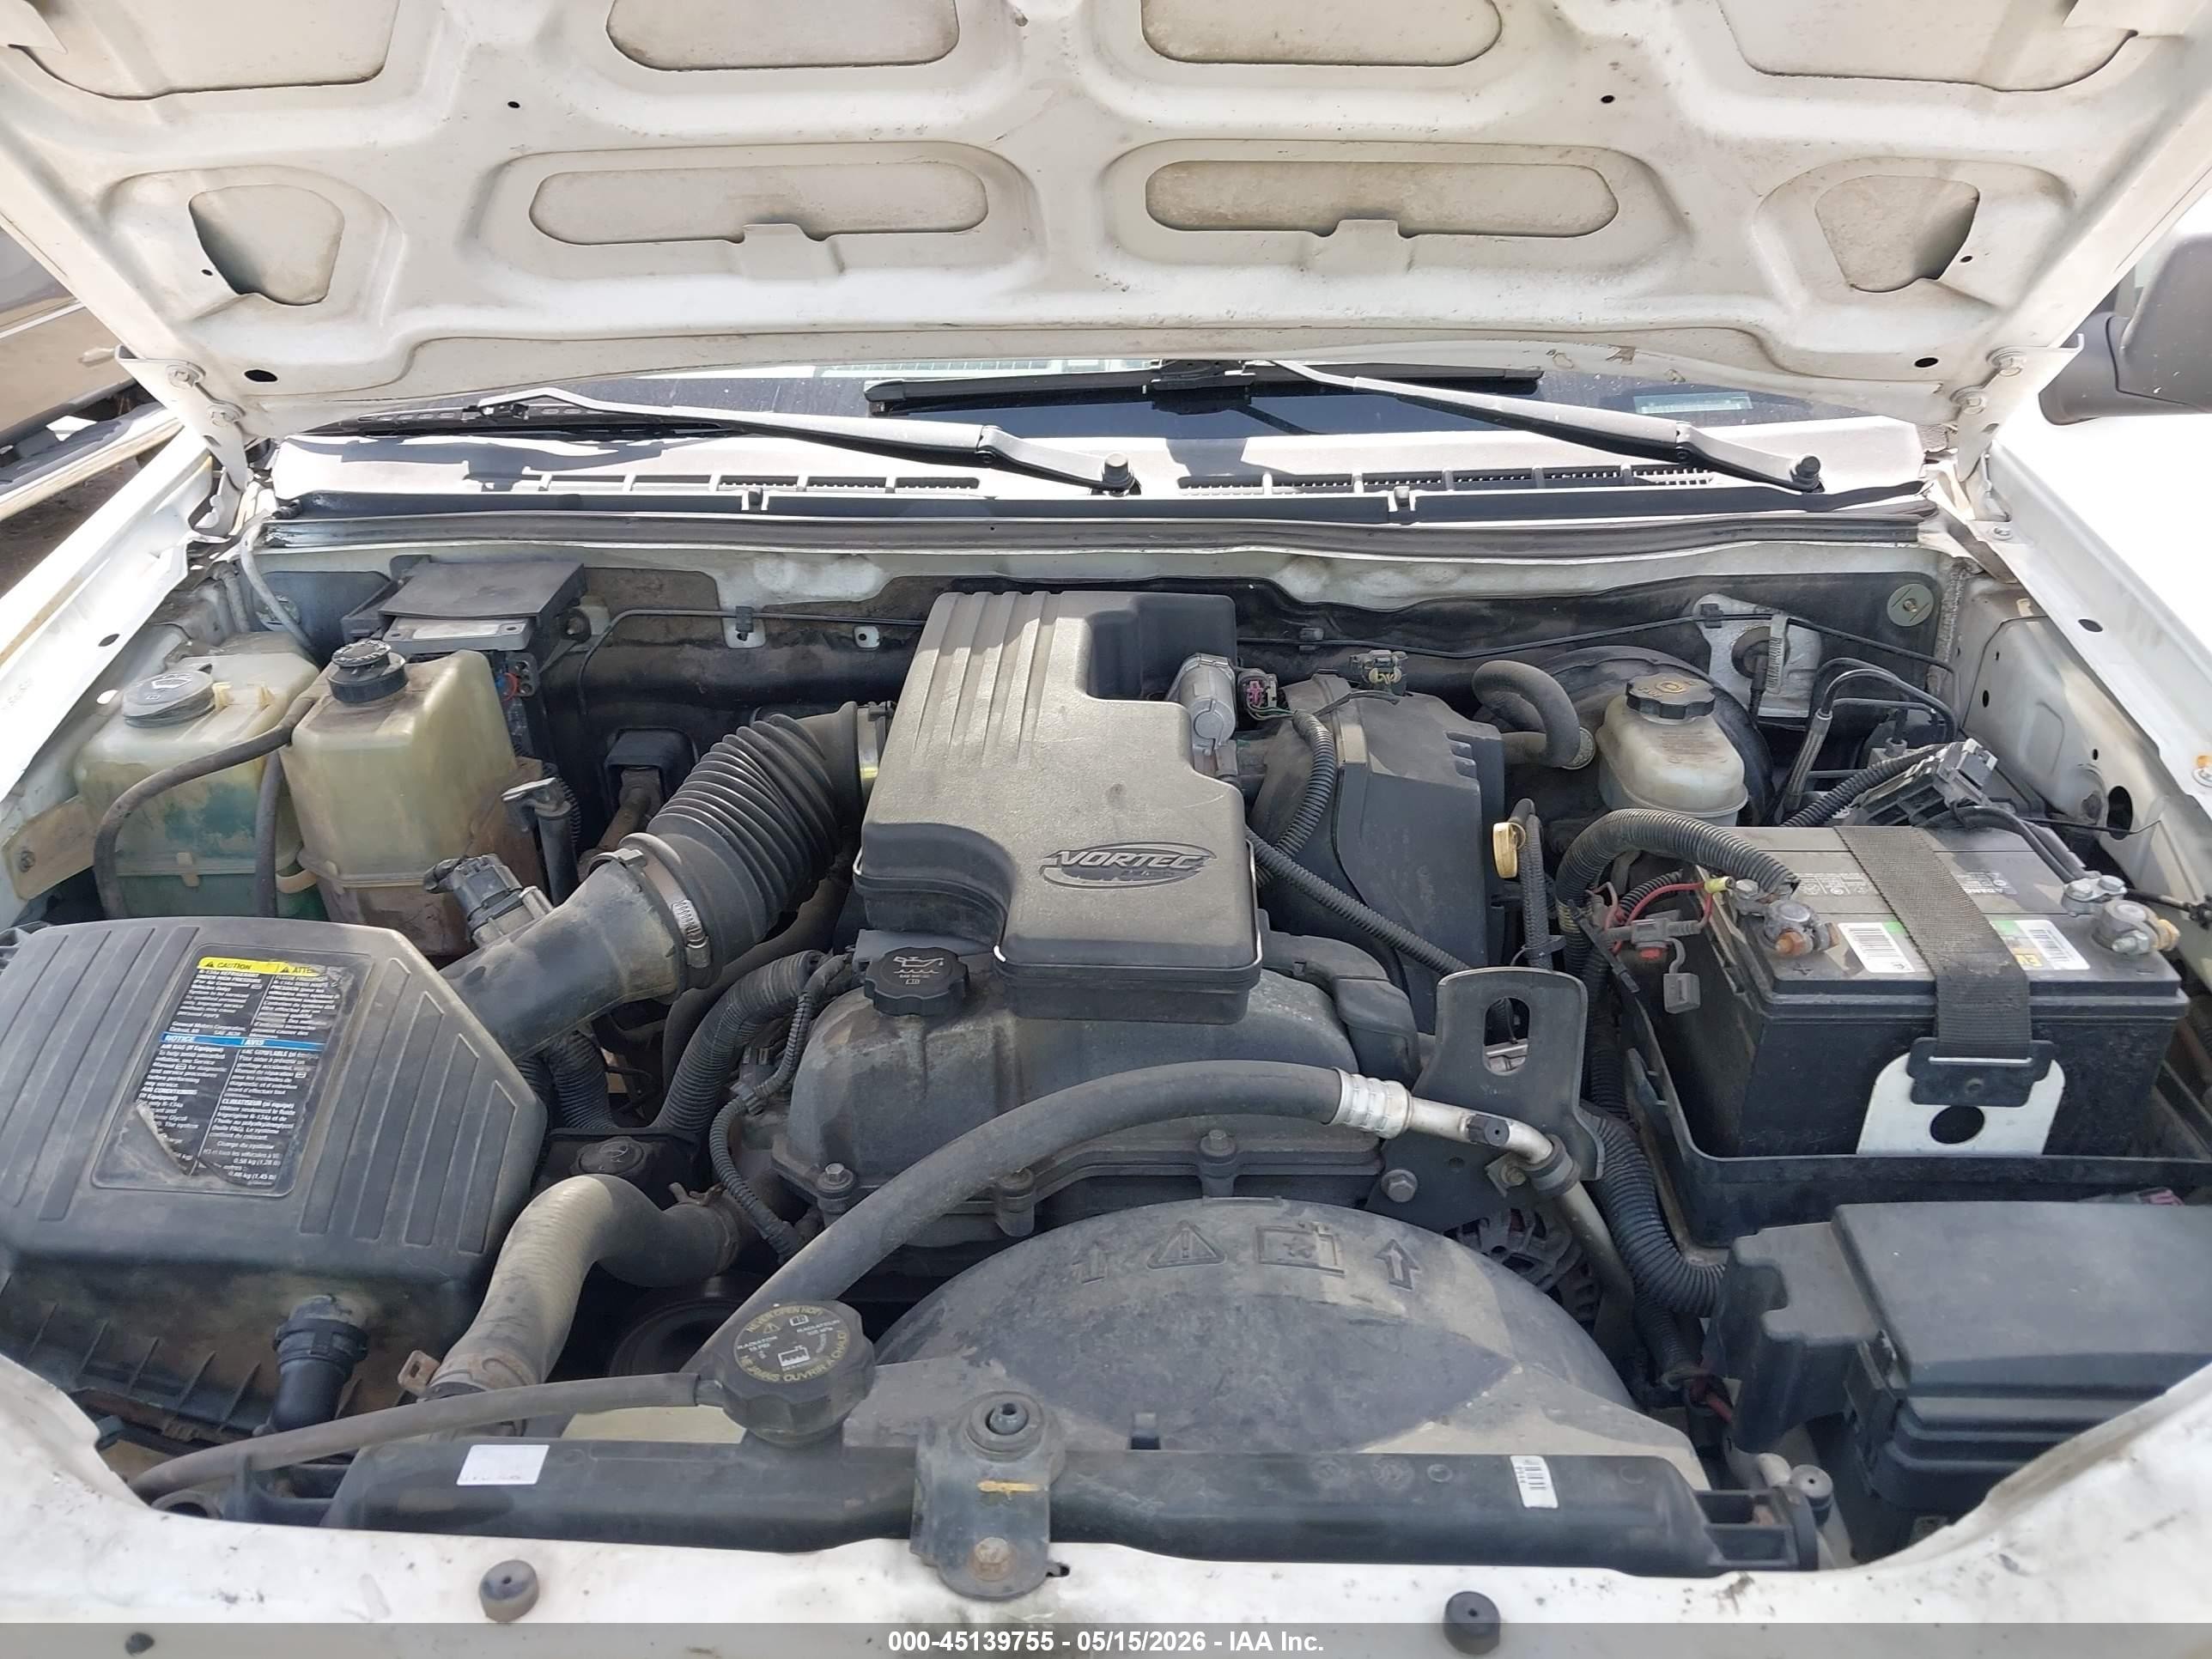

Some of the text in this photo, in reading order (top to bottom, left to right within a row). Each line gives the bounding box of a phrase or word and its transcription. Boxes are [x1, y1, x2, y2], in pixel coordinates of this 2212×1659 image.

[1055, 850, 1202, 870] VORTEC
[216, 962, 252, 970] CAUTION
[746, 1311, 775, 1333] NEVER
[774, 1305, 799, 1317] OPEN
[796, 1319, 840, 1334] RADIATEUR
[737, 1335, 777, 1350] RADIATOR
[782, 1364, 827, 1382] OUVRIR
